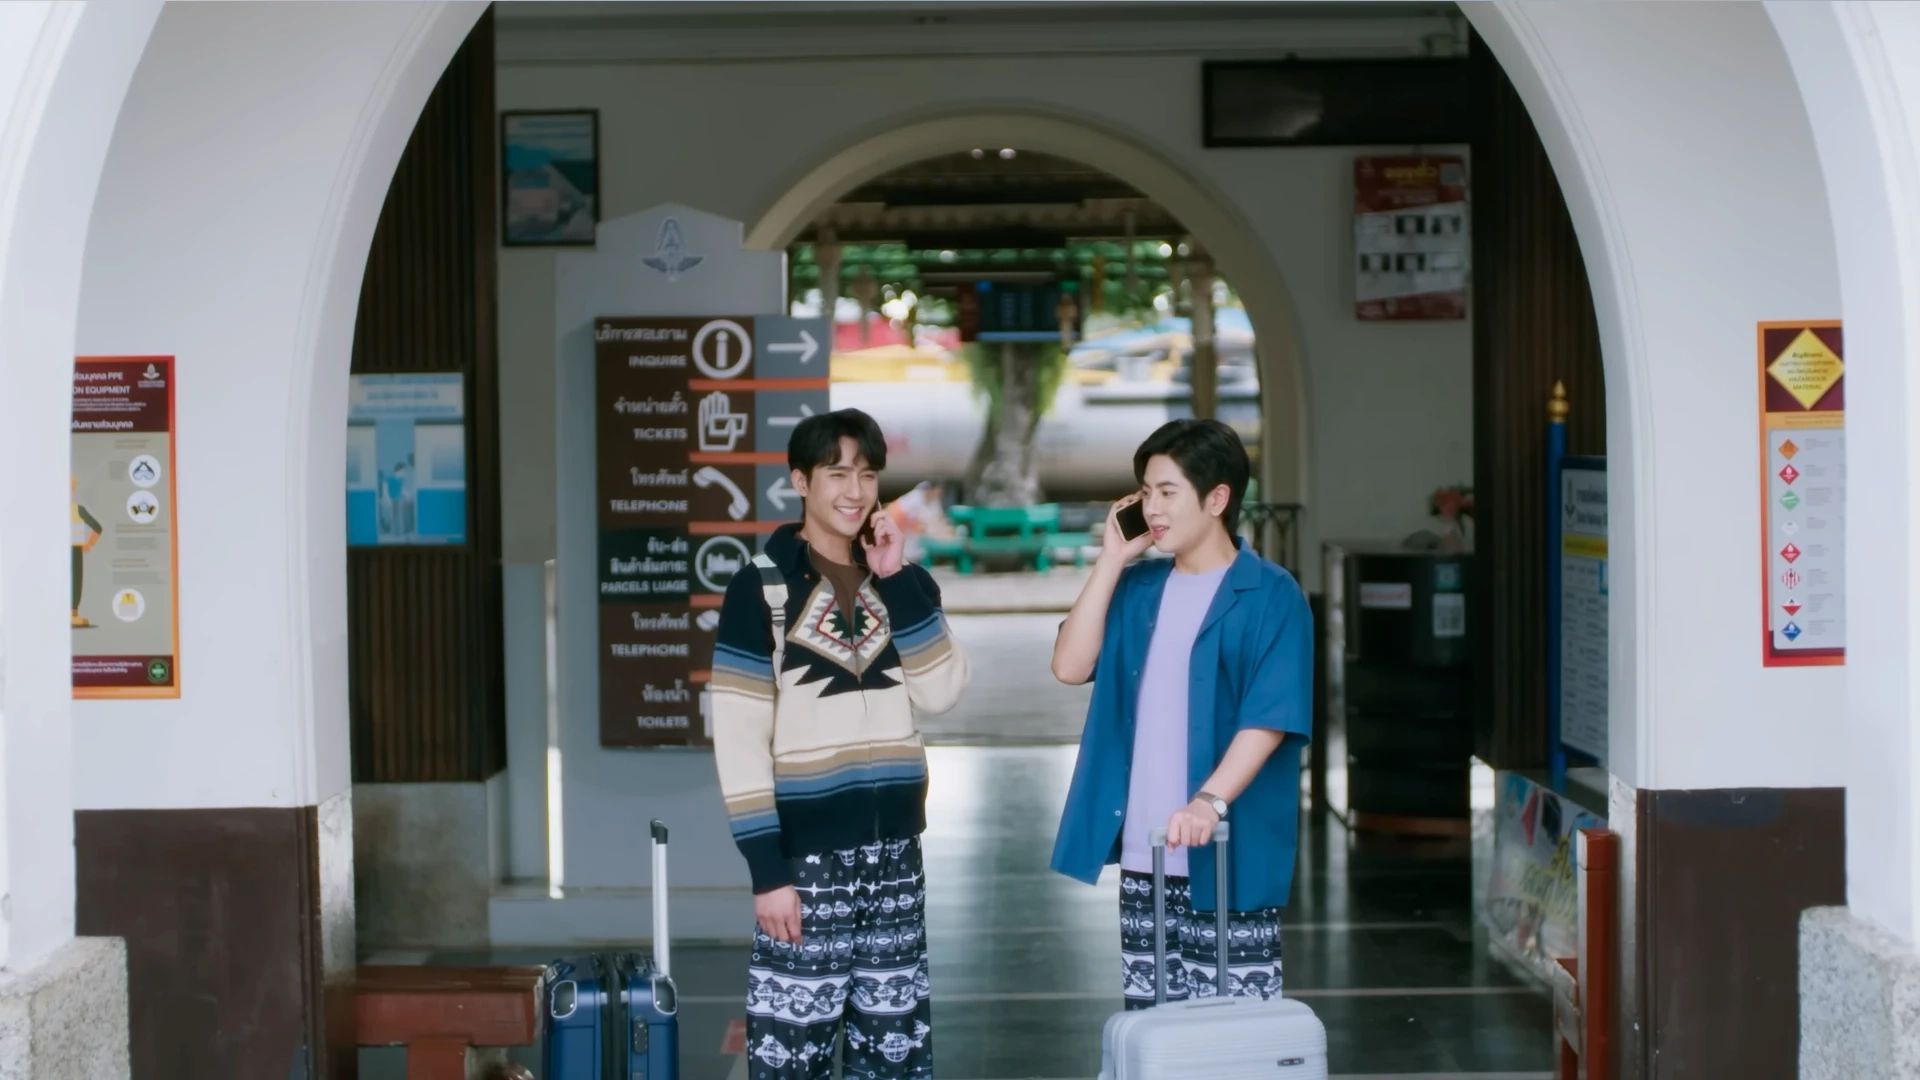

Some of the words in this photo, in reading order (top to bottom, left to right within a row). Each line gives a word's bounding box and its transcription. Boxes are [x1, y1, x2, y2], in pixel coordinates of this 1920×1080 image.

[628, 355, 688, 367] INQUIRE
[108, 372, 123, 381] PPE
[85, 385, 131, 395] EQUIPMENT
[633, 427, 688, 440] TICKETS
[630, 466, 688, 486] โทรศัพท์
[610, 499, 689, 512] TELEPHONE
[601, 581, 650, 593] PARCELS
[652, 580, 689, 592] LUAGE
[631, 611, 689, 630] โทรศัพท์
[610, 643, 690, 656] TELEPHONE
[642, 678, 690, 702] ห้องน้ำ
[636, 715, 690, 728] TOILETS
